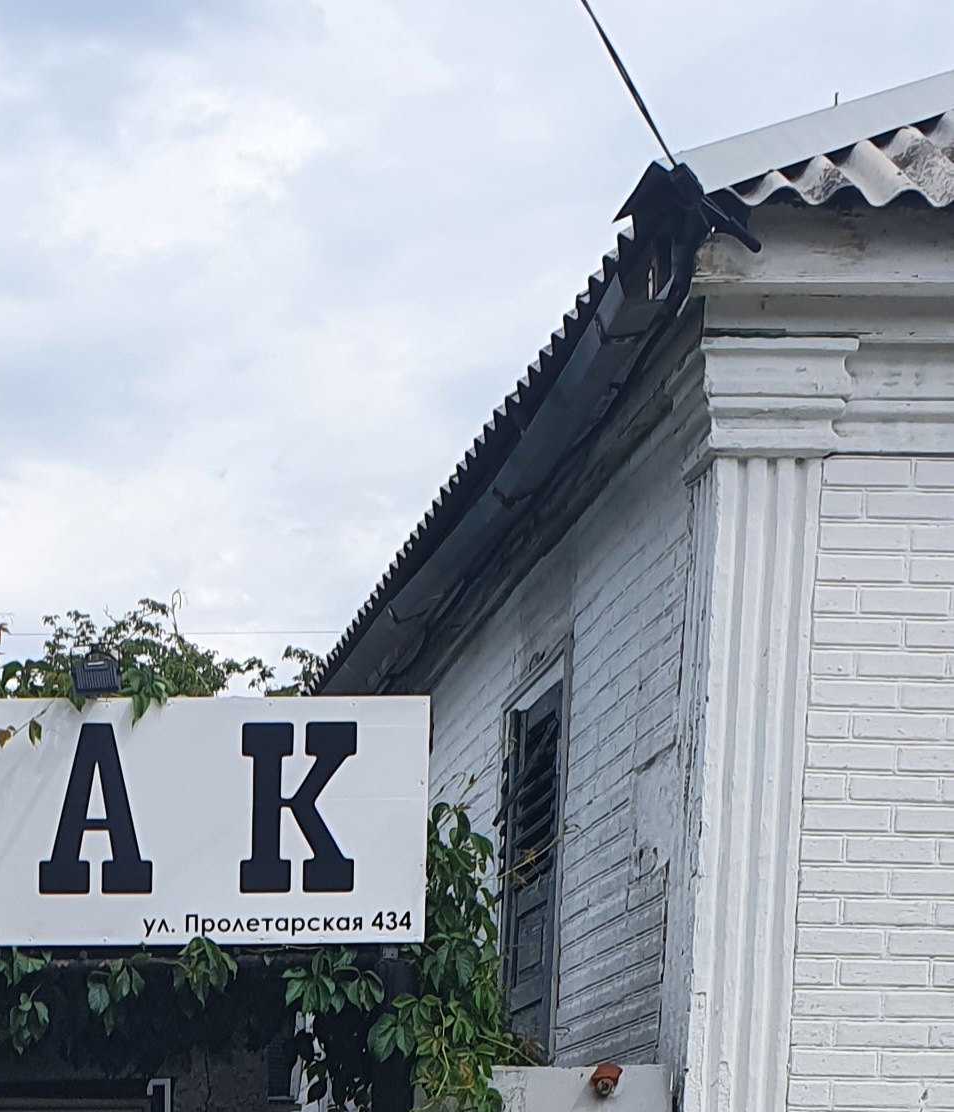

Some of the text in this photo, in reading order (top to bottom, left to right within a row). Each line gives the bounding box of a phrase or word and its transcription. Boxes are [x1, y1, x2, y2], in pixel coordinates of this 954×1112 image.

[142, 910, 413, 937] ул. Пролетарская 434
